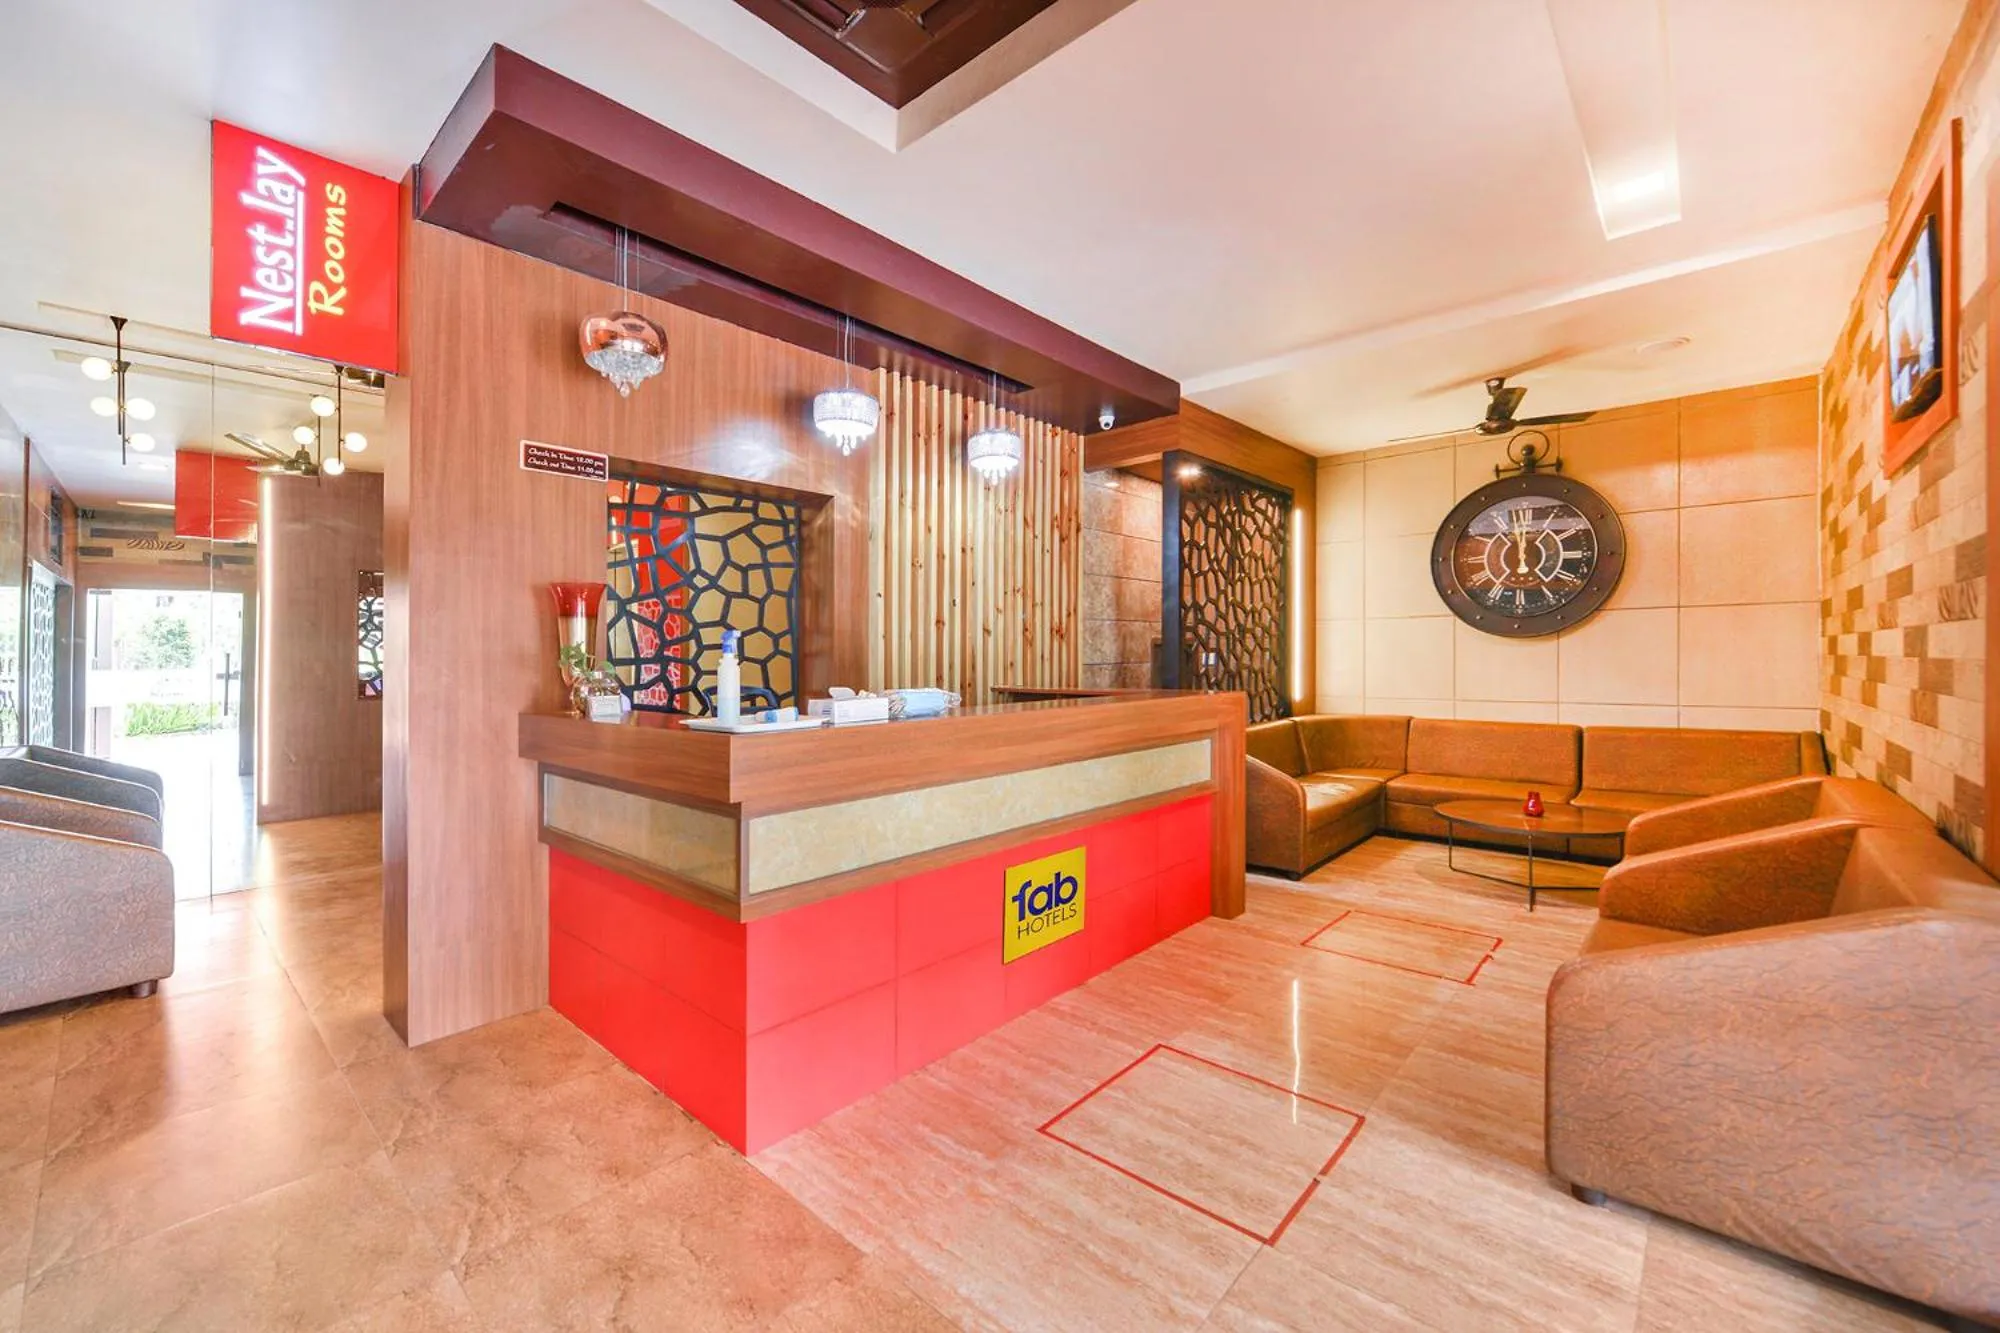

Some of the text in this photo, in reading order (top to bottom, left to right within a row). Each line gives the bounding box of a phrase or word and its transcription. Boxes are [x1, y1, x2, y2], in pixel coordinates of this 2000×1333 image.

[308, 182, 347, 315] Rooms
[1011, 871, 1078, 922] fab
[1017, 902, 1078, 940] HOTELS
